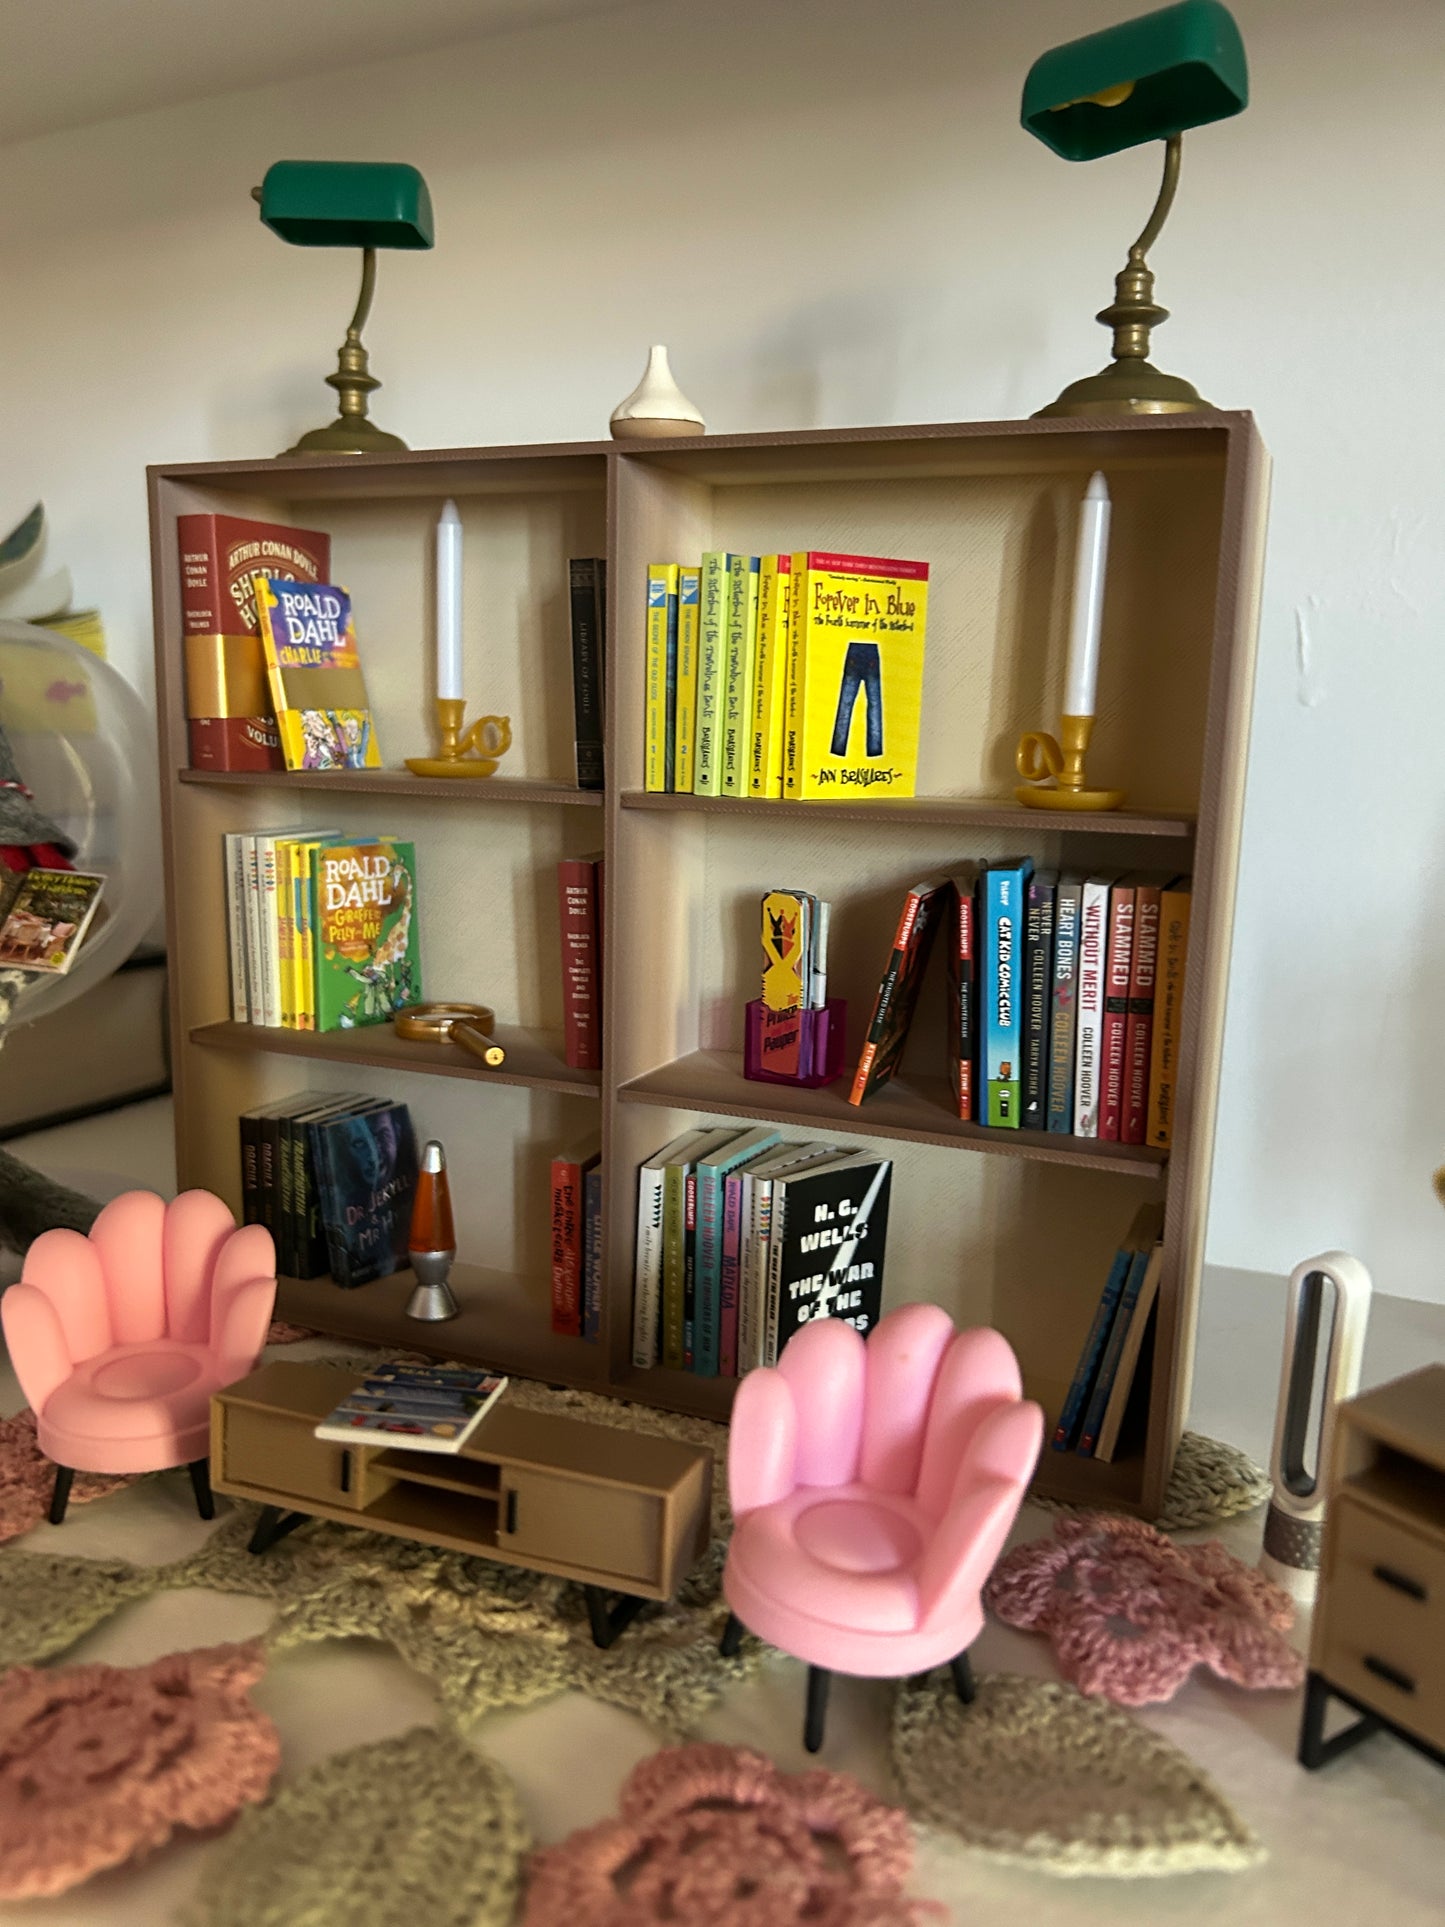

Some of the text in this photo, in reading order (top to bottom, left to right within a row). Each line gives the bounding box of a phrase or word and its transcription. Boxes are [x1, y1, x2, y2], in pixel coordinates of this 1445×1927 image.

[185, 566, 207, 575] CONAN
[229, 540, 319, 581] ARTHUR CONAN DOYLE
[187, 578, 207, 588] DOYLE
[814, 582, 859, 614] Forever
[887, 586, 915, 616] Blue
[281, 592, 341, 619] ROALD
[286, 616, 346, 648] DAHL
[280, 646, 322, 665] CHARLIE
[703, 695, 714, 719] Pants
[729, 697, 740, 720] Pants
[325, 856, 391, 884] ROALD
[326, 879, 392, 910] DAHL
[566, 886, 588, 895] ARTHUR
[567, 896, 587, 905] CONAN
[335, 908, 374, 926] GIRAFFE
[568, 906, 587, 915] DOYLE
[898, 897, 918, 946] GOOSEBUMPS
[1028, 908, 1040, 941] NEVER
[1041, 901, 1053, 935] NEVER
[329, 921, 380, 943] PELLY ME
[960, 904, 969, 954] GOOSEBUMPS
[999, 917, 1012, 940] CAT
[1056, 898, 1075, 979] HEART BONES
[1112, 903, 1134, 986] SLAMMED
[1135, 904, 1158, 986] SLAMMED
[1081, 904, 1101, 1013] WITHOUT MERIT
[881, 983, 893, 1007] HAUNTED
[1031, 948, 1045, 1030] COLLEEN HOOVER
[998, 999, 1012, 1027] CLUB
[764, 1029, 799, 1052] Pauper
[1028, 1039, 1040, 1095] TARRYN FISHER
[1051, 1011, 1070, 1112] COLLEEN HOOVER
[1080, 1027, 1094, 1107] COLLEEN HOOVER
[1107, 1022, 1124, 1106] COLLEEN HOOVER
[1130, 1023, 1147, 1108] COLLEEN HOOVER
[246, 1144, 257, 1190] DRACULA
[262, 1142, 273, 1188] DRACULA
[687, 1180, 695, 1226] GOOSEBUMPS
[727, 1181, 737, 1208] ROALD
[702, 1175, 715, 1269] COLLEEN HOOVER
[800, 1222, 869, 1253] WELLS
[721, 1255, 737, 1310] MATILDA
[788, 1262, 874, 1300] THE WAR
[701, 1276, 712, 1321] REMINDERS
[826, 1289, 862, 1314] THE
